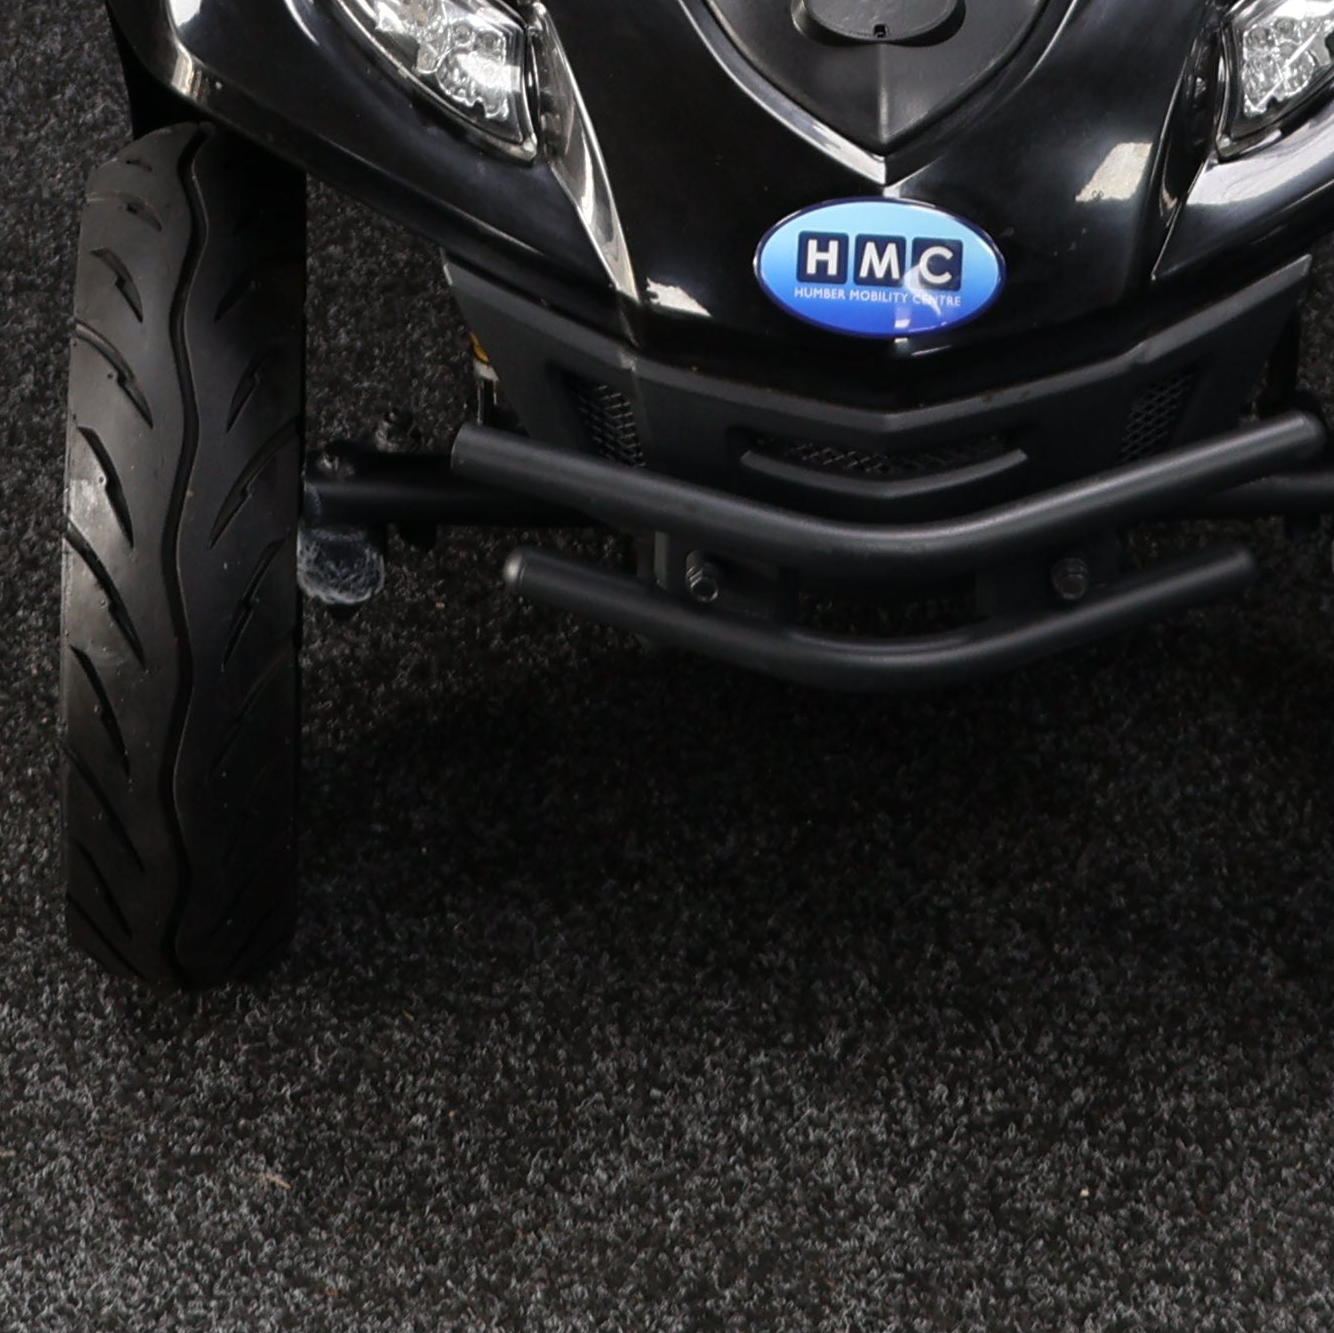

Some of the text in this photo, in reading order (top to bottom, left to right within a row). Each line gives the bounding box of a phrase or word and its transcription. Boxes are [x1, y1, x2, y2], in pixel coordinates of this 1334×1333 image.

[805, 239, 954, 284] HMC
[794, 287, 845, 301] HUMBER
[849, 290, 909, 304] MOBILITY
